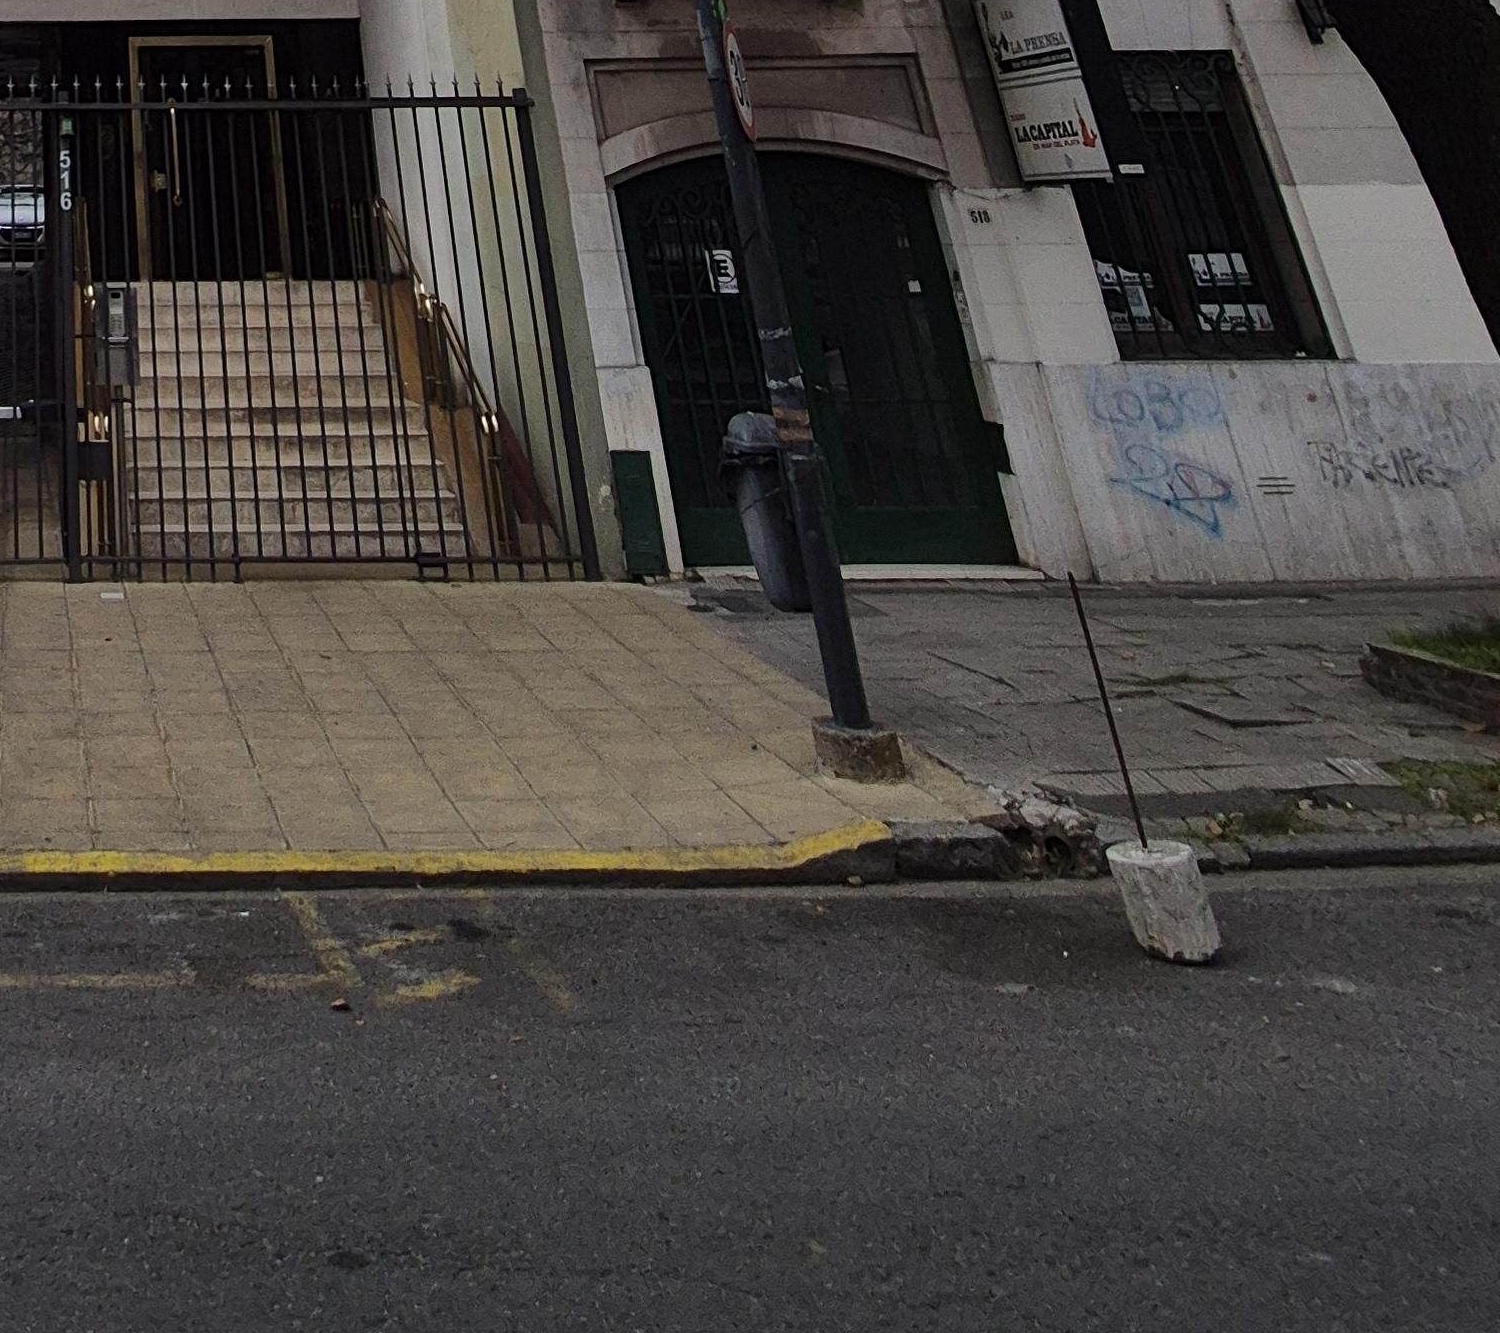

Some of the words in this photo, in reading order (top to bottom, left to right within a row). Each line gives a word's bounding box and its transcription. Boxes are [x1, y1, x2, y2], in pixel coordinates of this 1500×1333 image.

[1009, 38, 1024, 54] LA
[1023, 31, 1067, 52] PRENSA
[59, 150, 72, 211] 516
